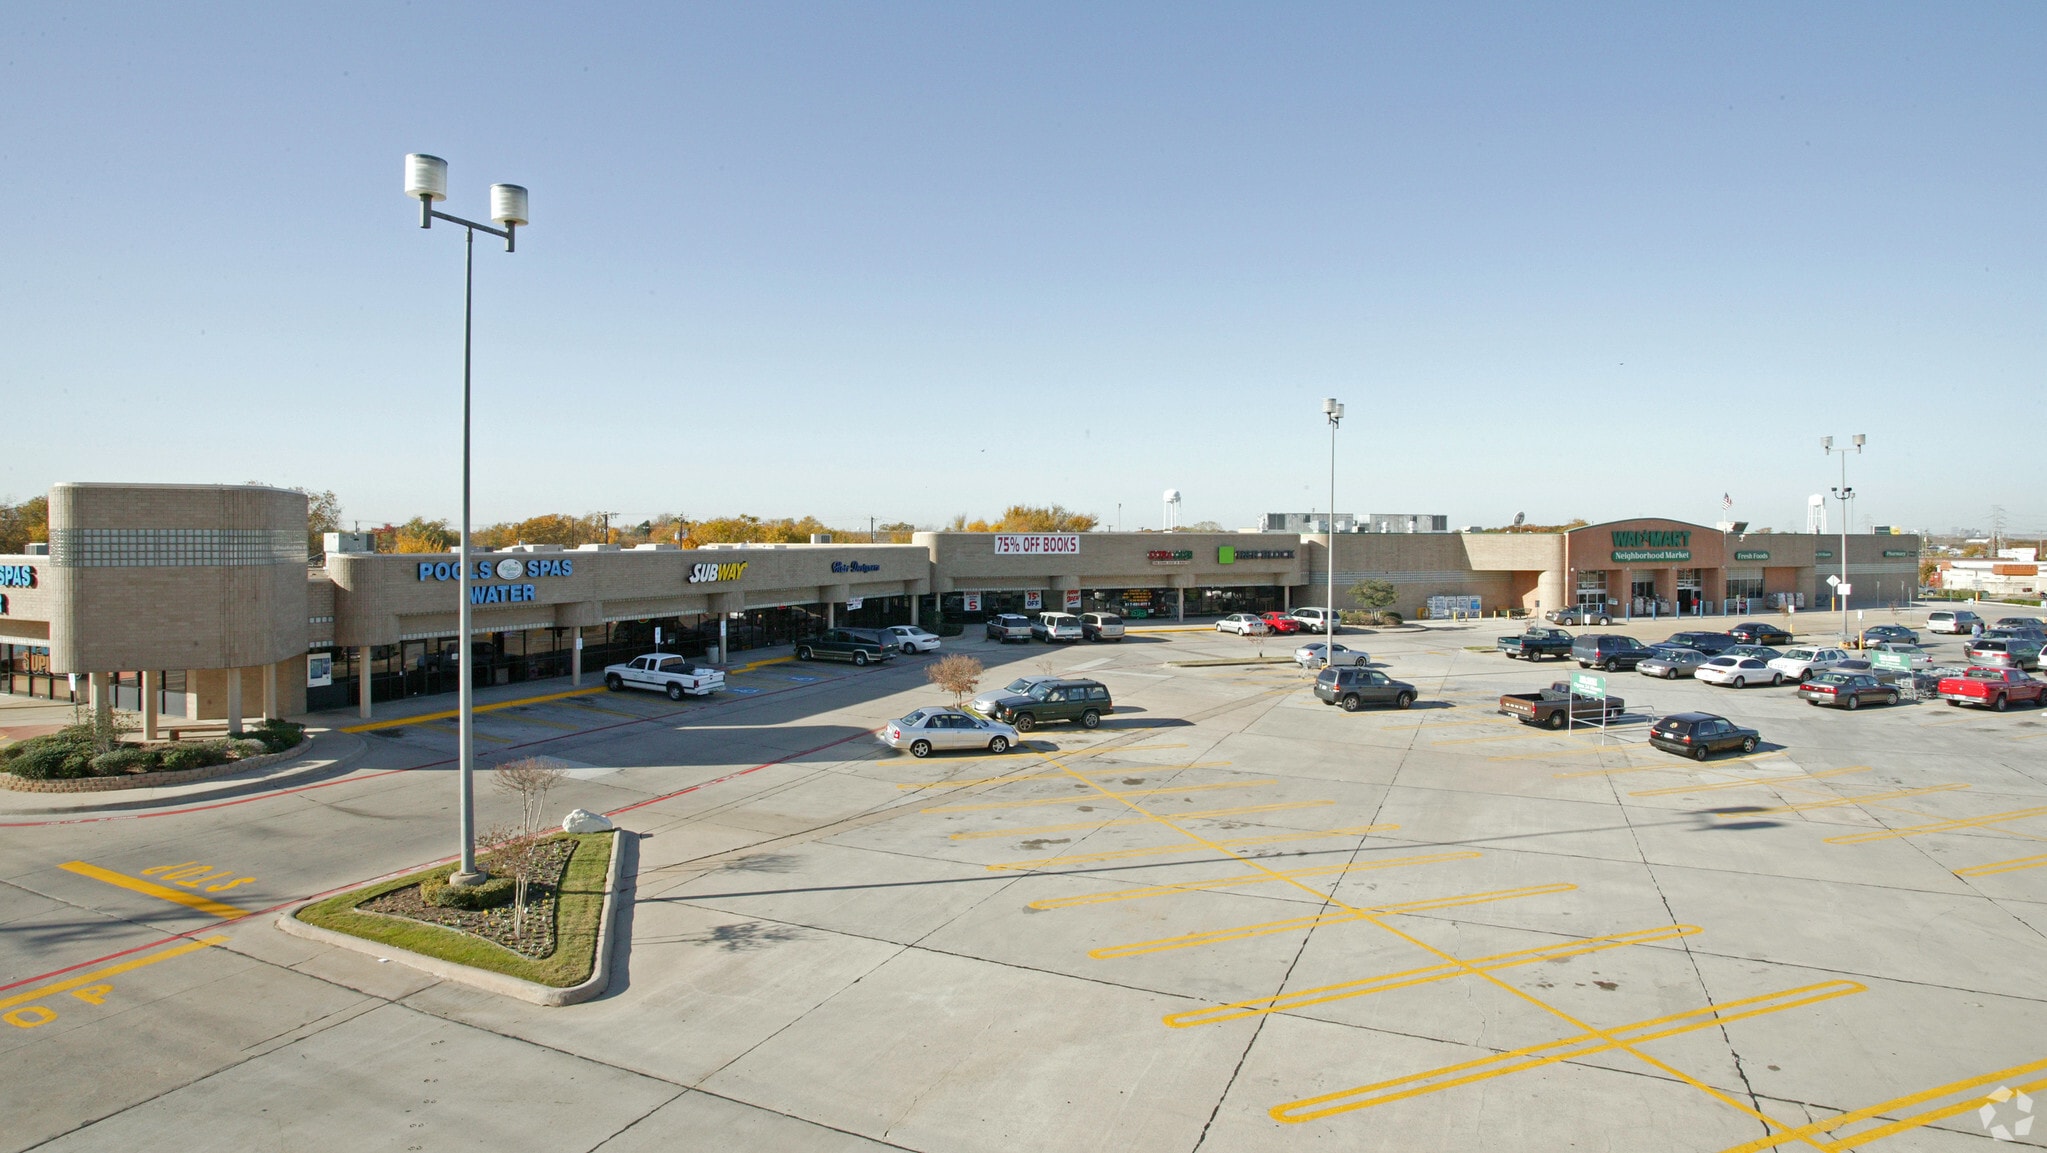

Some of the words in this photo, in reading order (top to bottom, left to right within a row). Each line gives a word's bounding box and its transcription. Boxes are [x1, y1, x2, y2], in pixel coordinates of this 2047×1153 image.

[997, 537, 1020, 552] 75%
[1023, 537, 1041, 552] OFF
[1043, 537, 1077, 552] BOOKS
[1615, 552, 1665, 561] Neighborhood
[1665, 551, 1689, 559] Market
[1737, 552, 1753, 560] Fresh
[1753, 552, 1769, 560] Foods
[527, 559, 573, 578] SPAS
[690, 561, 748, 583] SUBWAY
[470, 584, 536, 605] WATER
[140, 861, 257, 893] STOP
